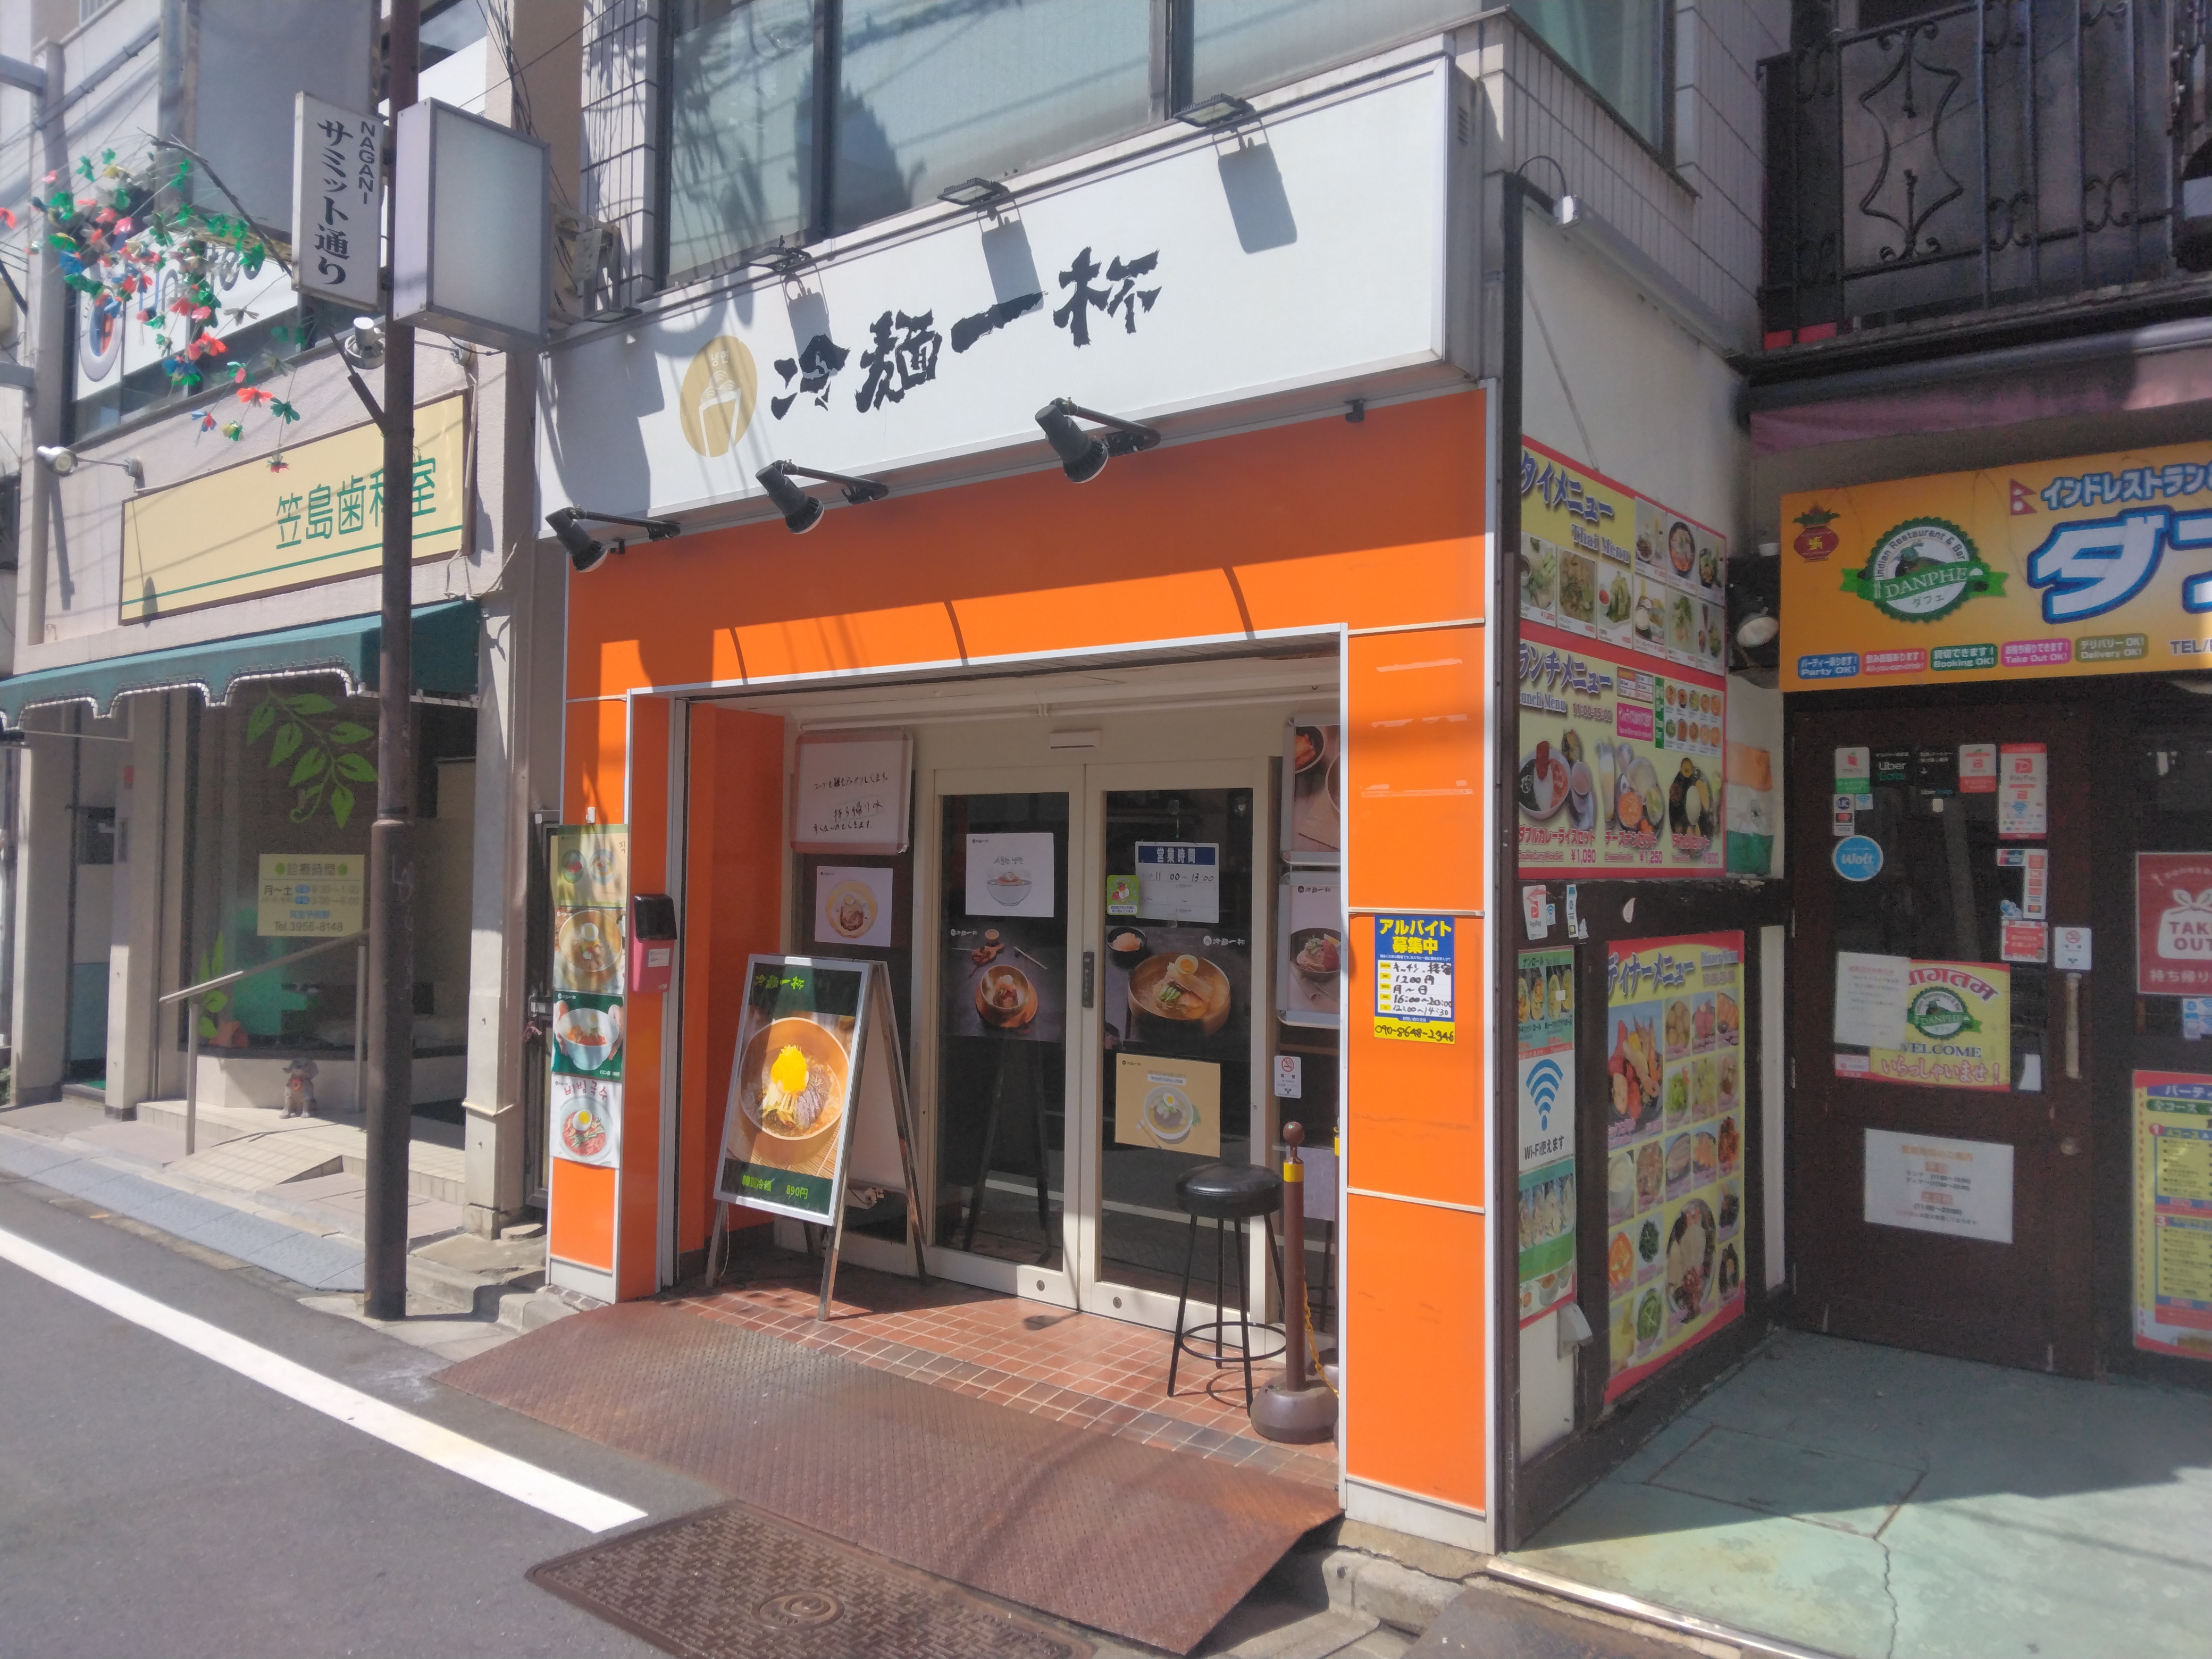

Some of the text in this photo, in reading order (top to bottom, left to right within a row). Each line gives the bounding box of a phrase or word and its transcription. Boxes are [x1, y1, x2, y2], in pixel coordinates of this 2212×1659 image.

[358, 120, 375, 205] NAGANI
[314, 119, 354, 286] サミット通り
[769, 246, 1163, 420] 冷麺一杯
[1521, 449, 1614, 522] タイメニュー
[2041, 460, 2212, 510] インドレストラン
[1571, 523, 1630, 564] Thai Menu
[1875, 528, 1967, 579] Indian Restaurant & Bar
[1884, 567, 1968, 599] DANPHE
[2081, 637, 2144, 649] デリバリー OK!
[2170, 639, 2212, 655] TEL/
[2050, 652, 2067, 661] OK!
[2081, 647, 2143, 659] Delivery OK!
[1520, 642, 1612, 694] ランチメニュー
[1933, 659, 1973, 668] Booking
[1544, 693, 1566, 713] Menu
[1879, 761, 1906, 770] Uber
[1519, 824, 1596, 847] ダブルカレーライスセット
[1605, 830, 1657, 848] チーズナンセット
[1157, 847, 1196, 864] 営業時間
[1571, 849, 1596, 865] ¥1,090
[264, 885, 293, 896] 月～土
[1379, 918, 1452, 937] アルバイト
[2168, 921, 2212, 935] TAK
[1392, 936, 1438, 955] 募集中
[1395, 975, 1435, 986] 1200円
[1608, 952, 1695, 995] ディナーメニュー
[564, 1079, 608, 1101] 비빔국수
[1524, 1135, 1565, 1160] Wi-Fi使えます
[786, 1184, 809, 1200] 890円
